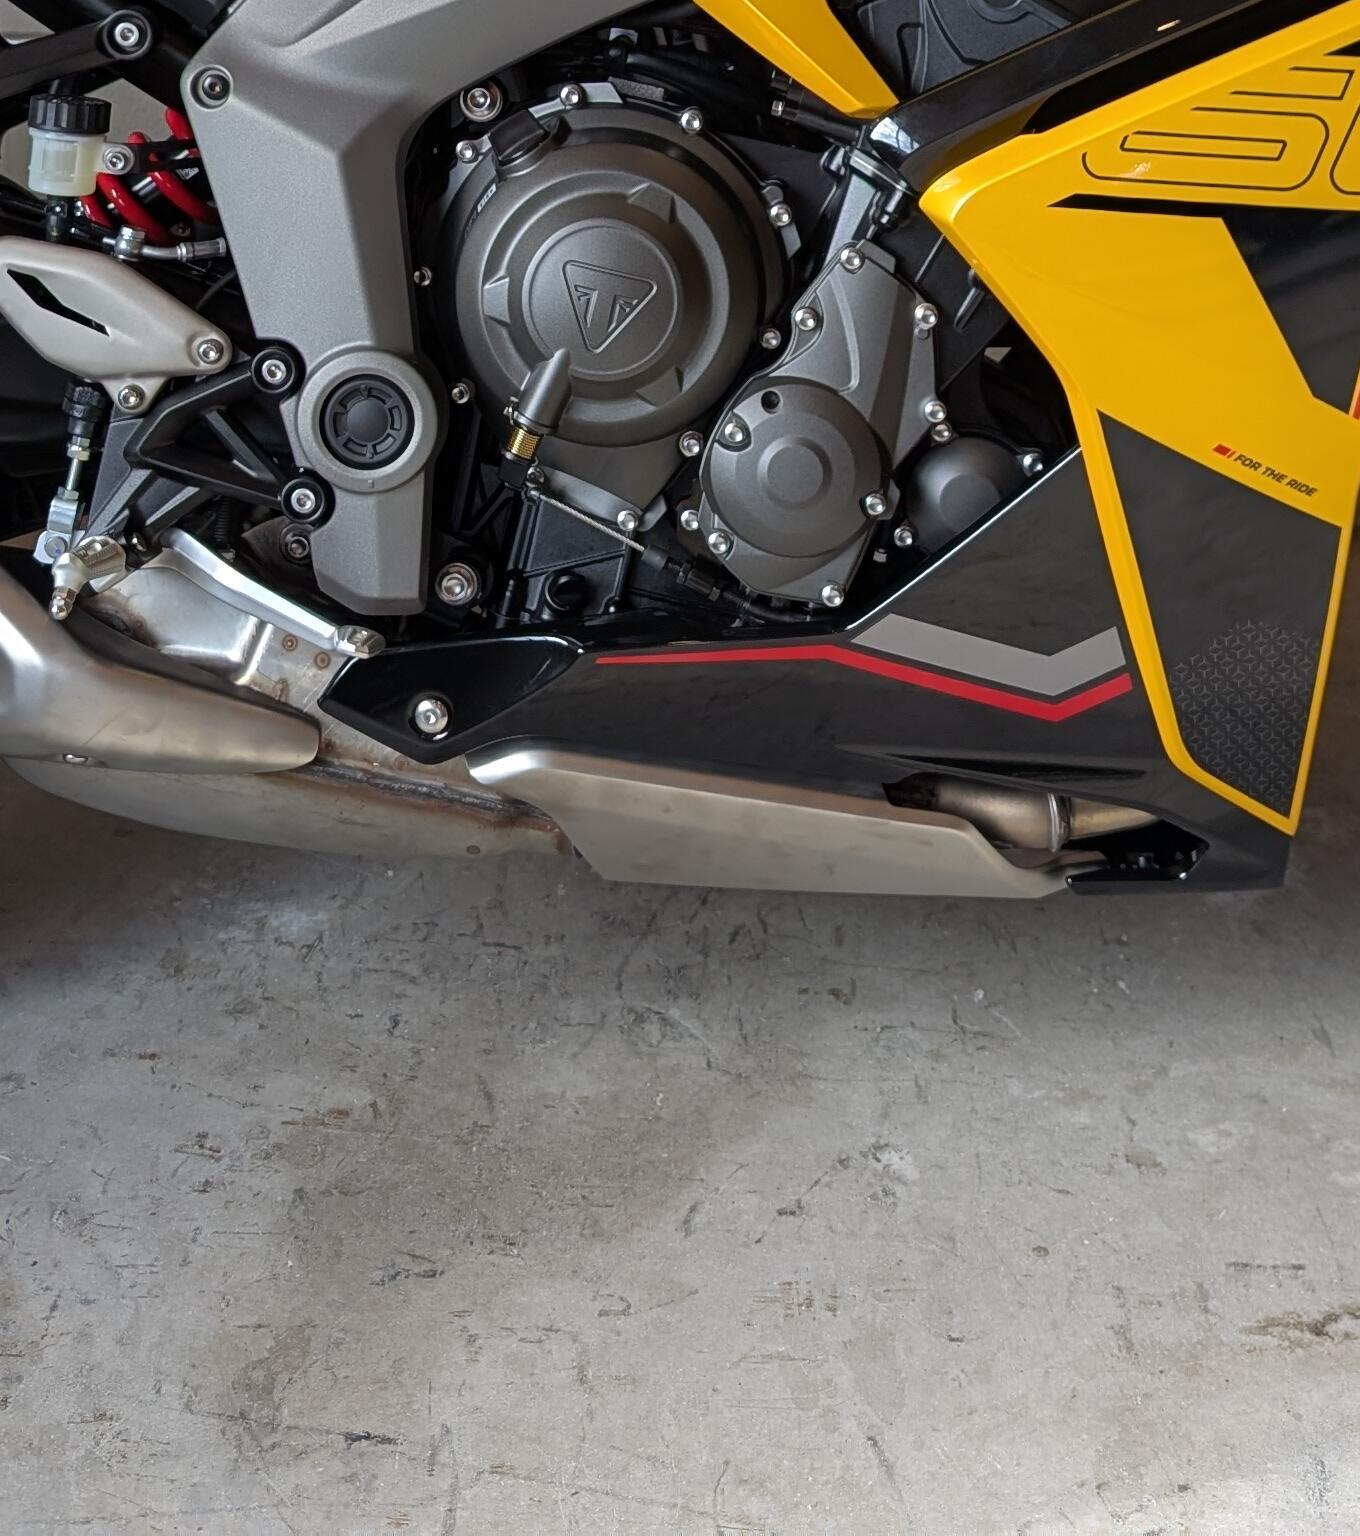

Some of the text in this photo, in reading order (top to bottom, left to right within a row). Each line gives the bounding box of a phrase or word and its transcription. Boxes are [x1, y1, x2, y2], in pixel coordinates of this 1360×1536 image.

[1233, 453, 1318, 497] FOR THE RIDE
